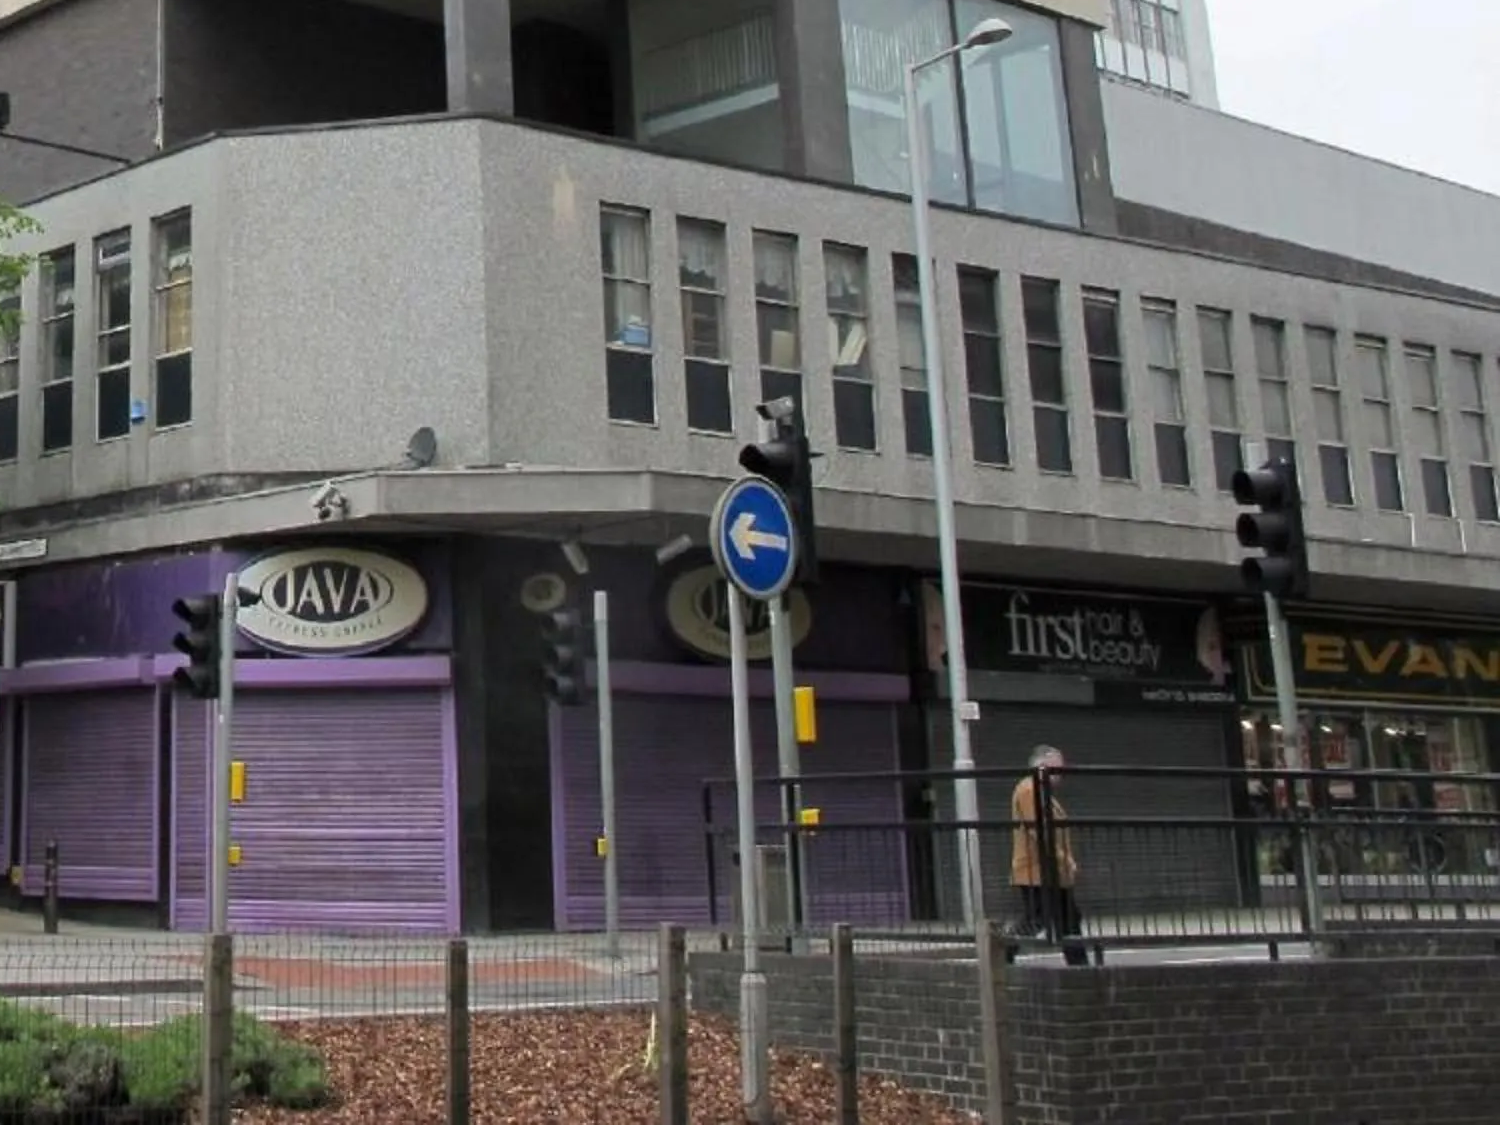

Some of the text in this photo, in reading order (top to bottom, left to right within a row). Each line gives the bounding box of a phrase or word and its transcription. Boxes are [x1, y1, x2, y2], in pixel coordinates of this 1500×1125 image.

[264, 566, 383, 615] JAVA
[1005, 589, 1087, 660] first
[1089, 635, 1161, 671] beauty
[1302, 633, 1500, 681] EVAN
